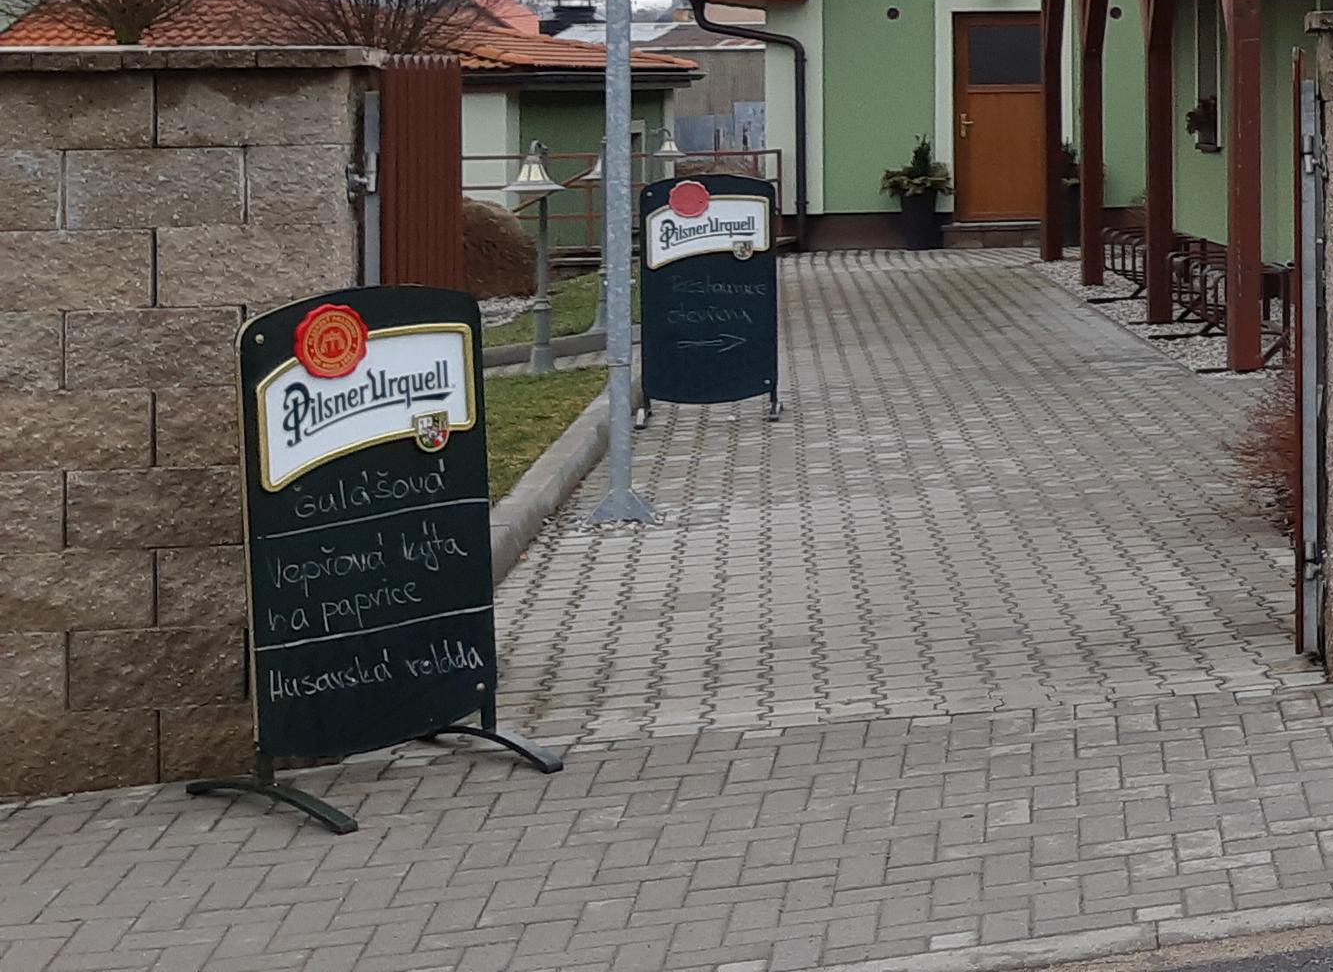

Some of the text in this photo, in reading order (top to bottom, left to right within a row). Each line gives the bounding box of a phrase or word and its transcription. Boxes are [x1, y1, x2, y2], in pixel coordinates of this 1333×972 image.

[659, 216, 755, 250] Pilsner Urquell
[282, 360, 449, 448] Pilsner Urquell
[321, 578, 423, 633] paprice
[269, 648, 393, 703] Husarská
